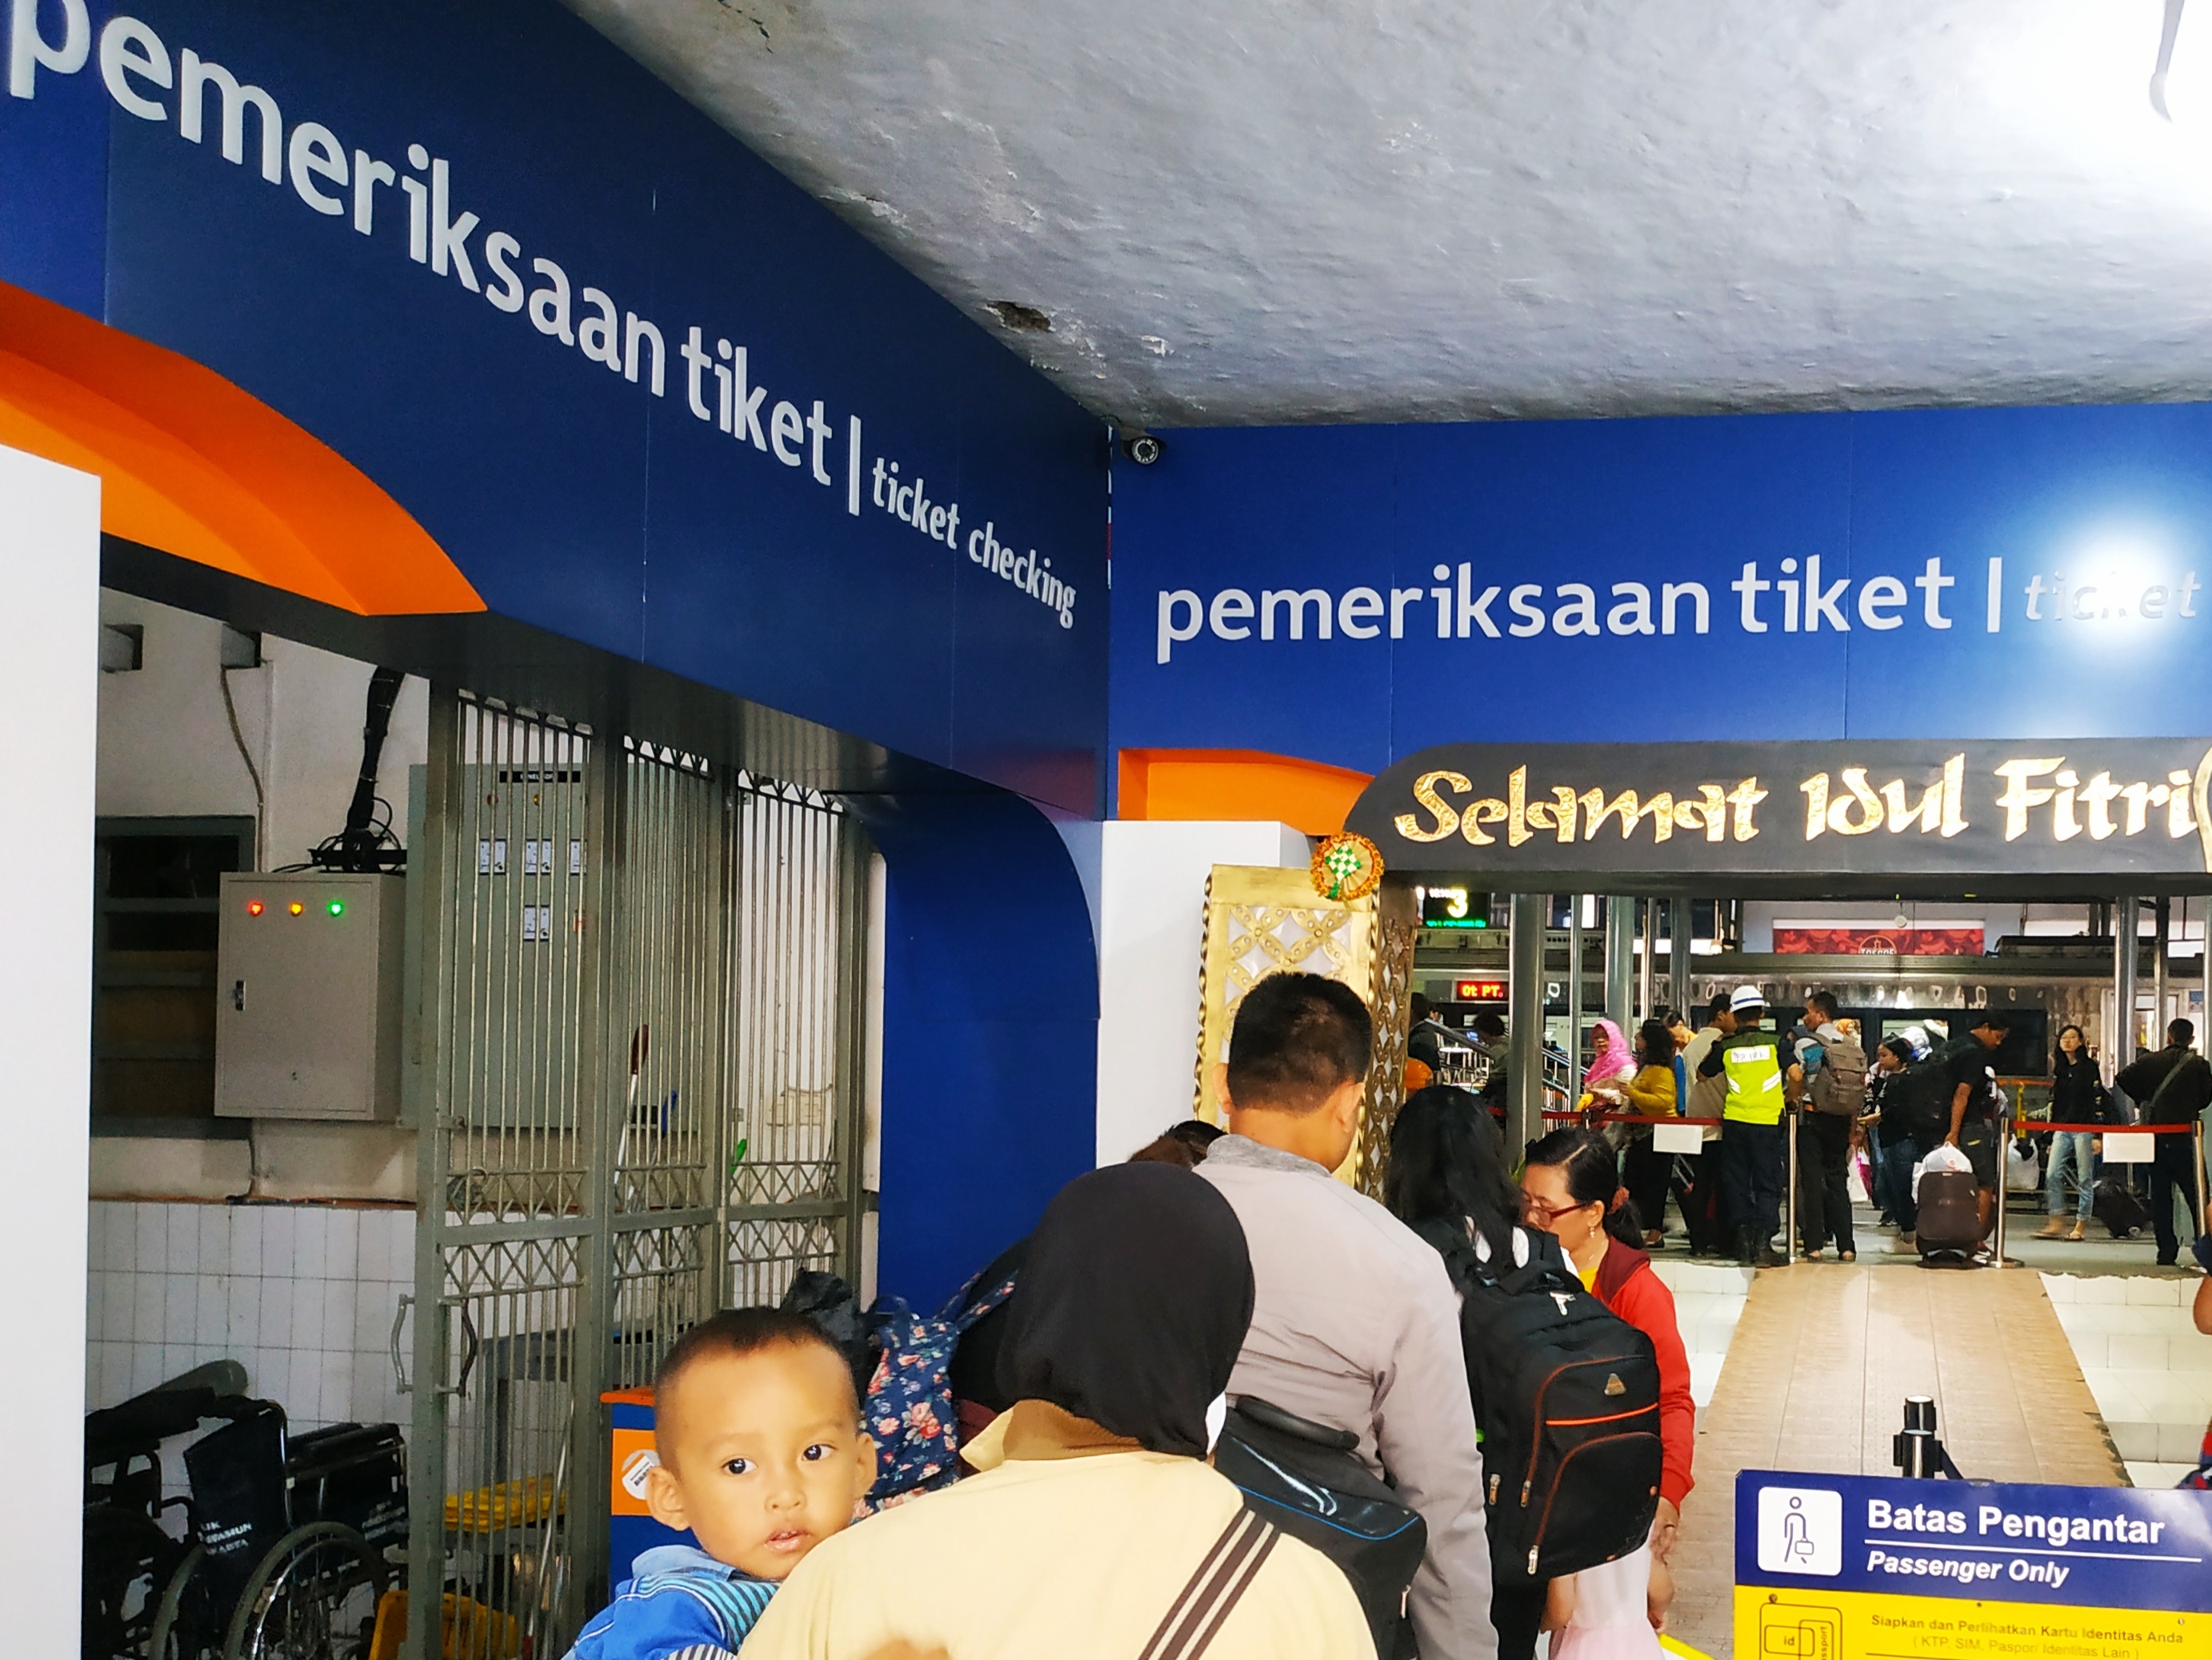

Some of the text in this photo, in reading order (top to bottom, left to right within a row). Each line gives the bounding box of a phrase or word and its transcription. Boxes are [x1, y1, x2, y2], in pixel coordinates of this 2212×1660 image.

[9, 0, 1077, 629] pemeriksaan tiket ticket checking
[1157, 562, 1710, 665] pemeriksaan
[1731, 554, 1955, 633] tiket
[1394, 764, 1769, 848] Selamat
[1994, 755, 2199, 842] Fitri
[1866, 1499, 2165, 1547] Batas Pengantar
[1866, 1551, 2070, 1588] Passenger Only
[1783, 1635, 1795, 1646] id
[1871, 1614, 2183, 1643] Siapkan dan Perlihatkan Kartu Identitas Anda
[2042, 1642, 2098, 1658] Identitas
[2102, 1646, 2130, 1658] Lain
